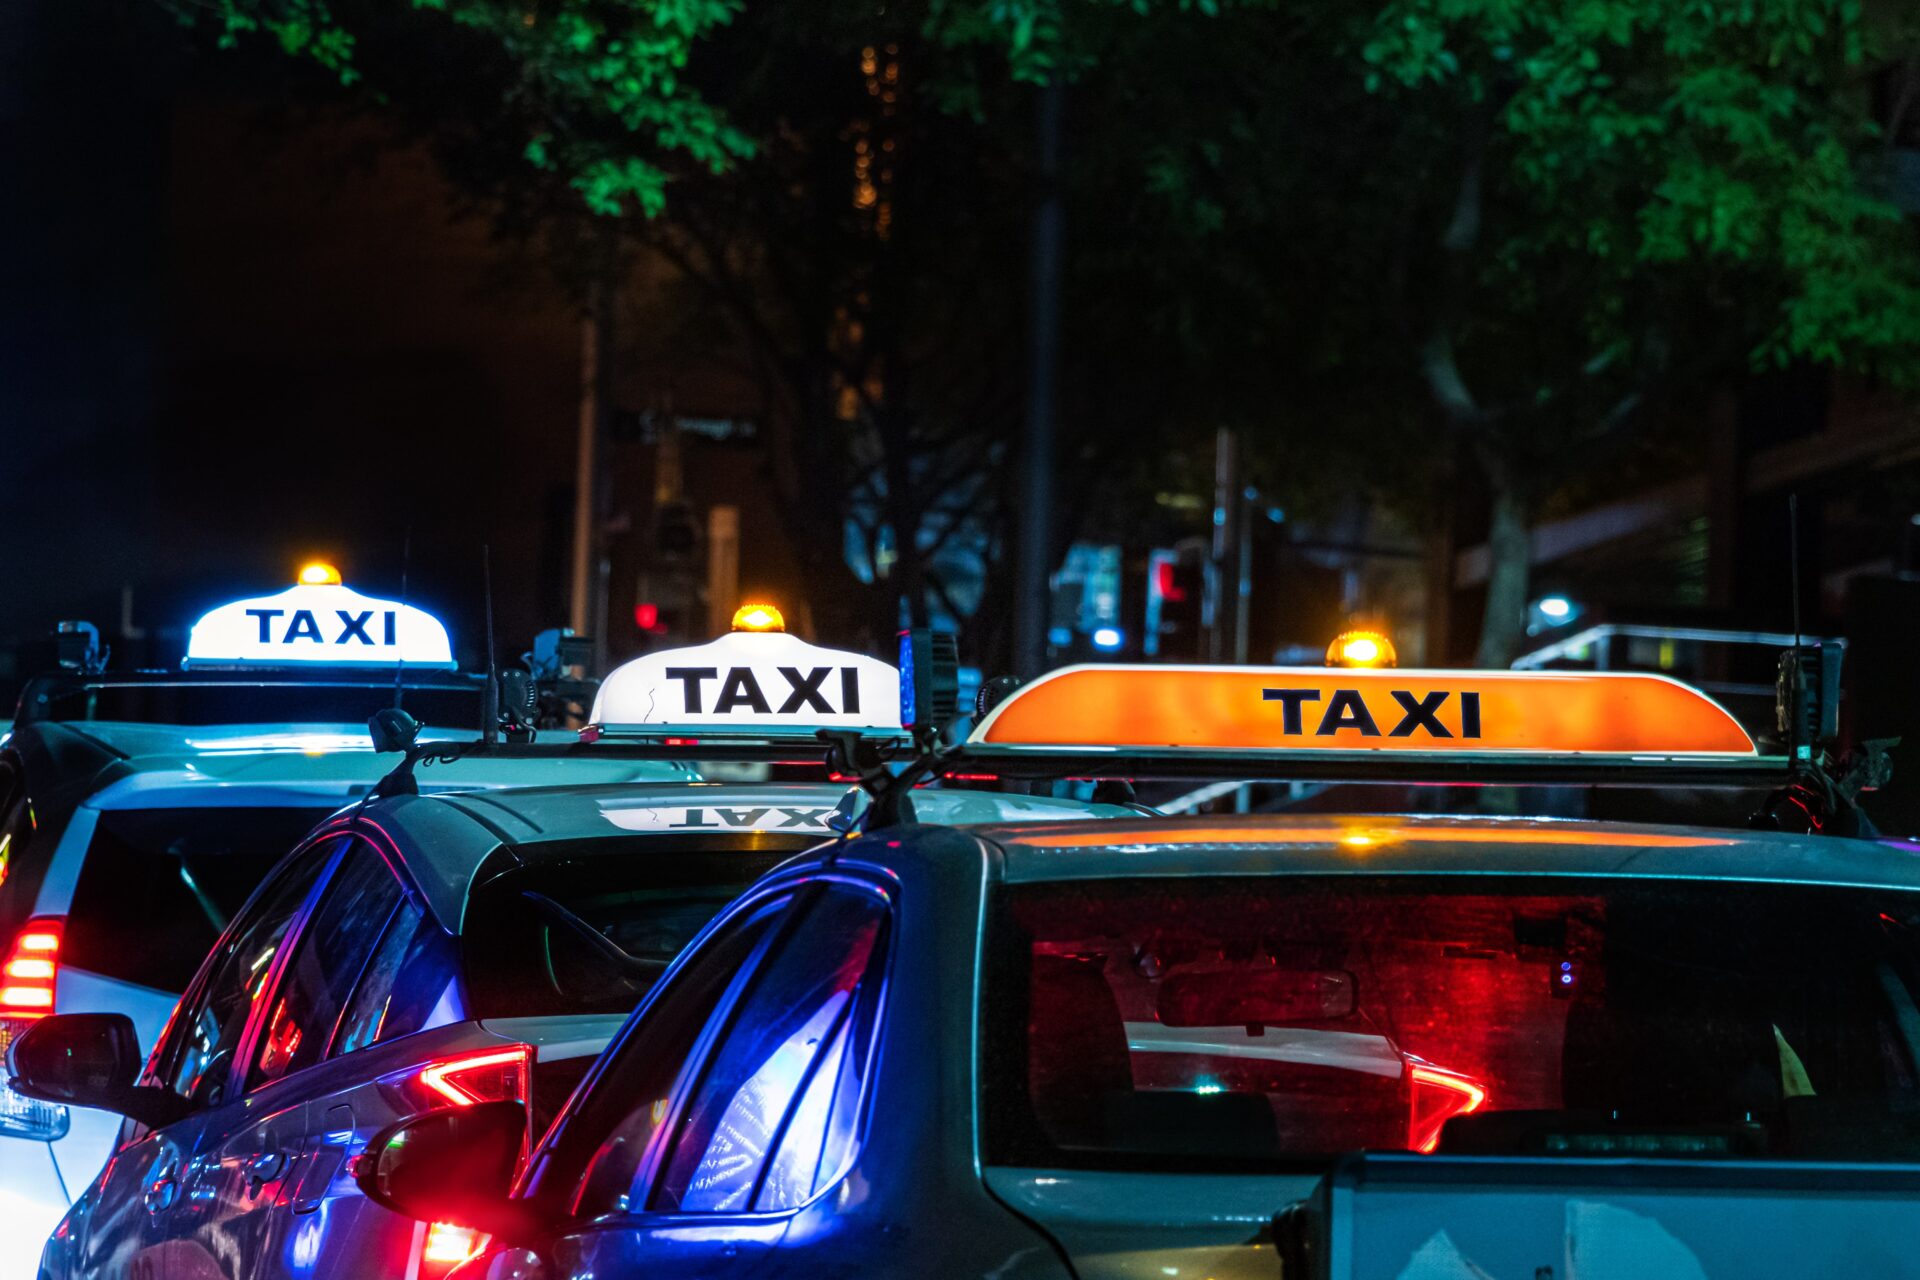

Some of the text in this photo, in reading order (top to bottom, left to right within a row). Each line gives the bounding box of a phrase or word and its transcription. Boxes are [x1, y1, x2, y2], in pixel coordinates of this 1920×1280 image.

[246, 609, 396, 645] TAXI
[666, 667, 860, 714] TAXI
[1262, 688, 1481, 738] TAXI
